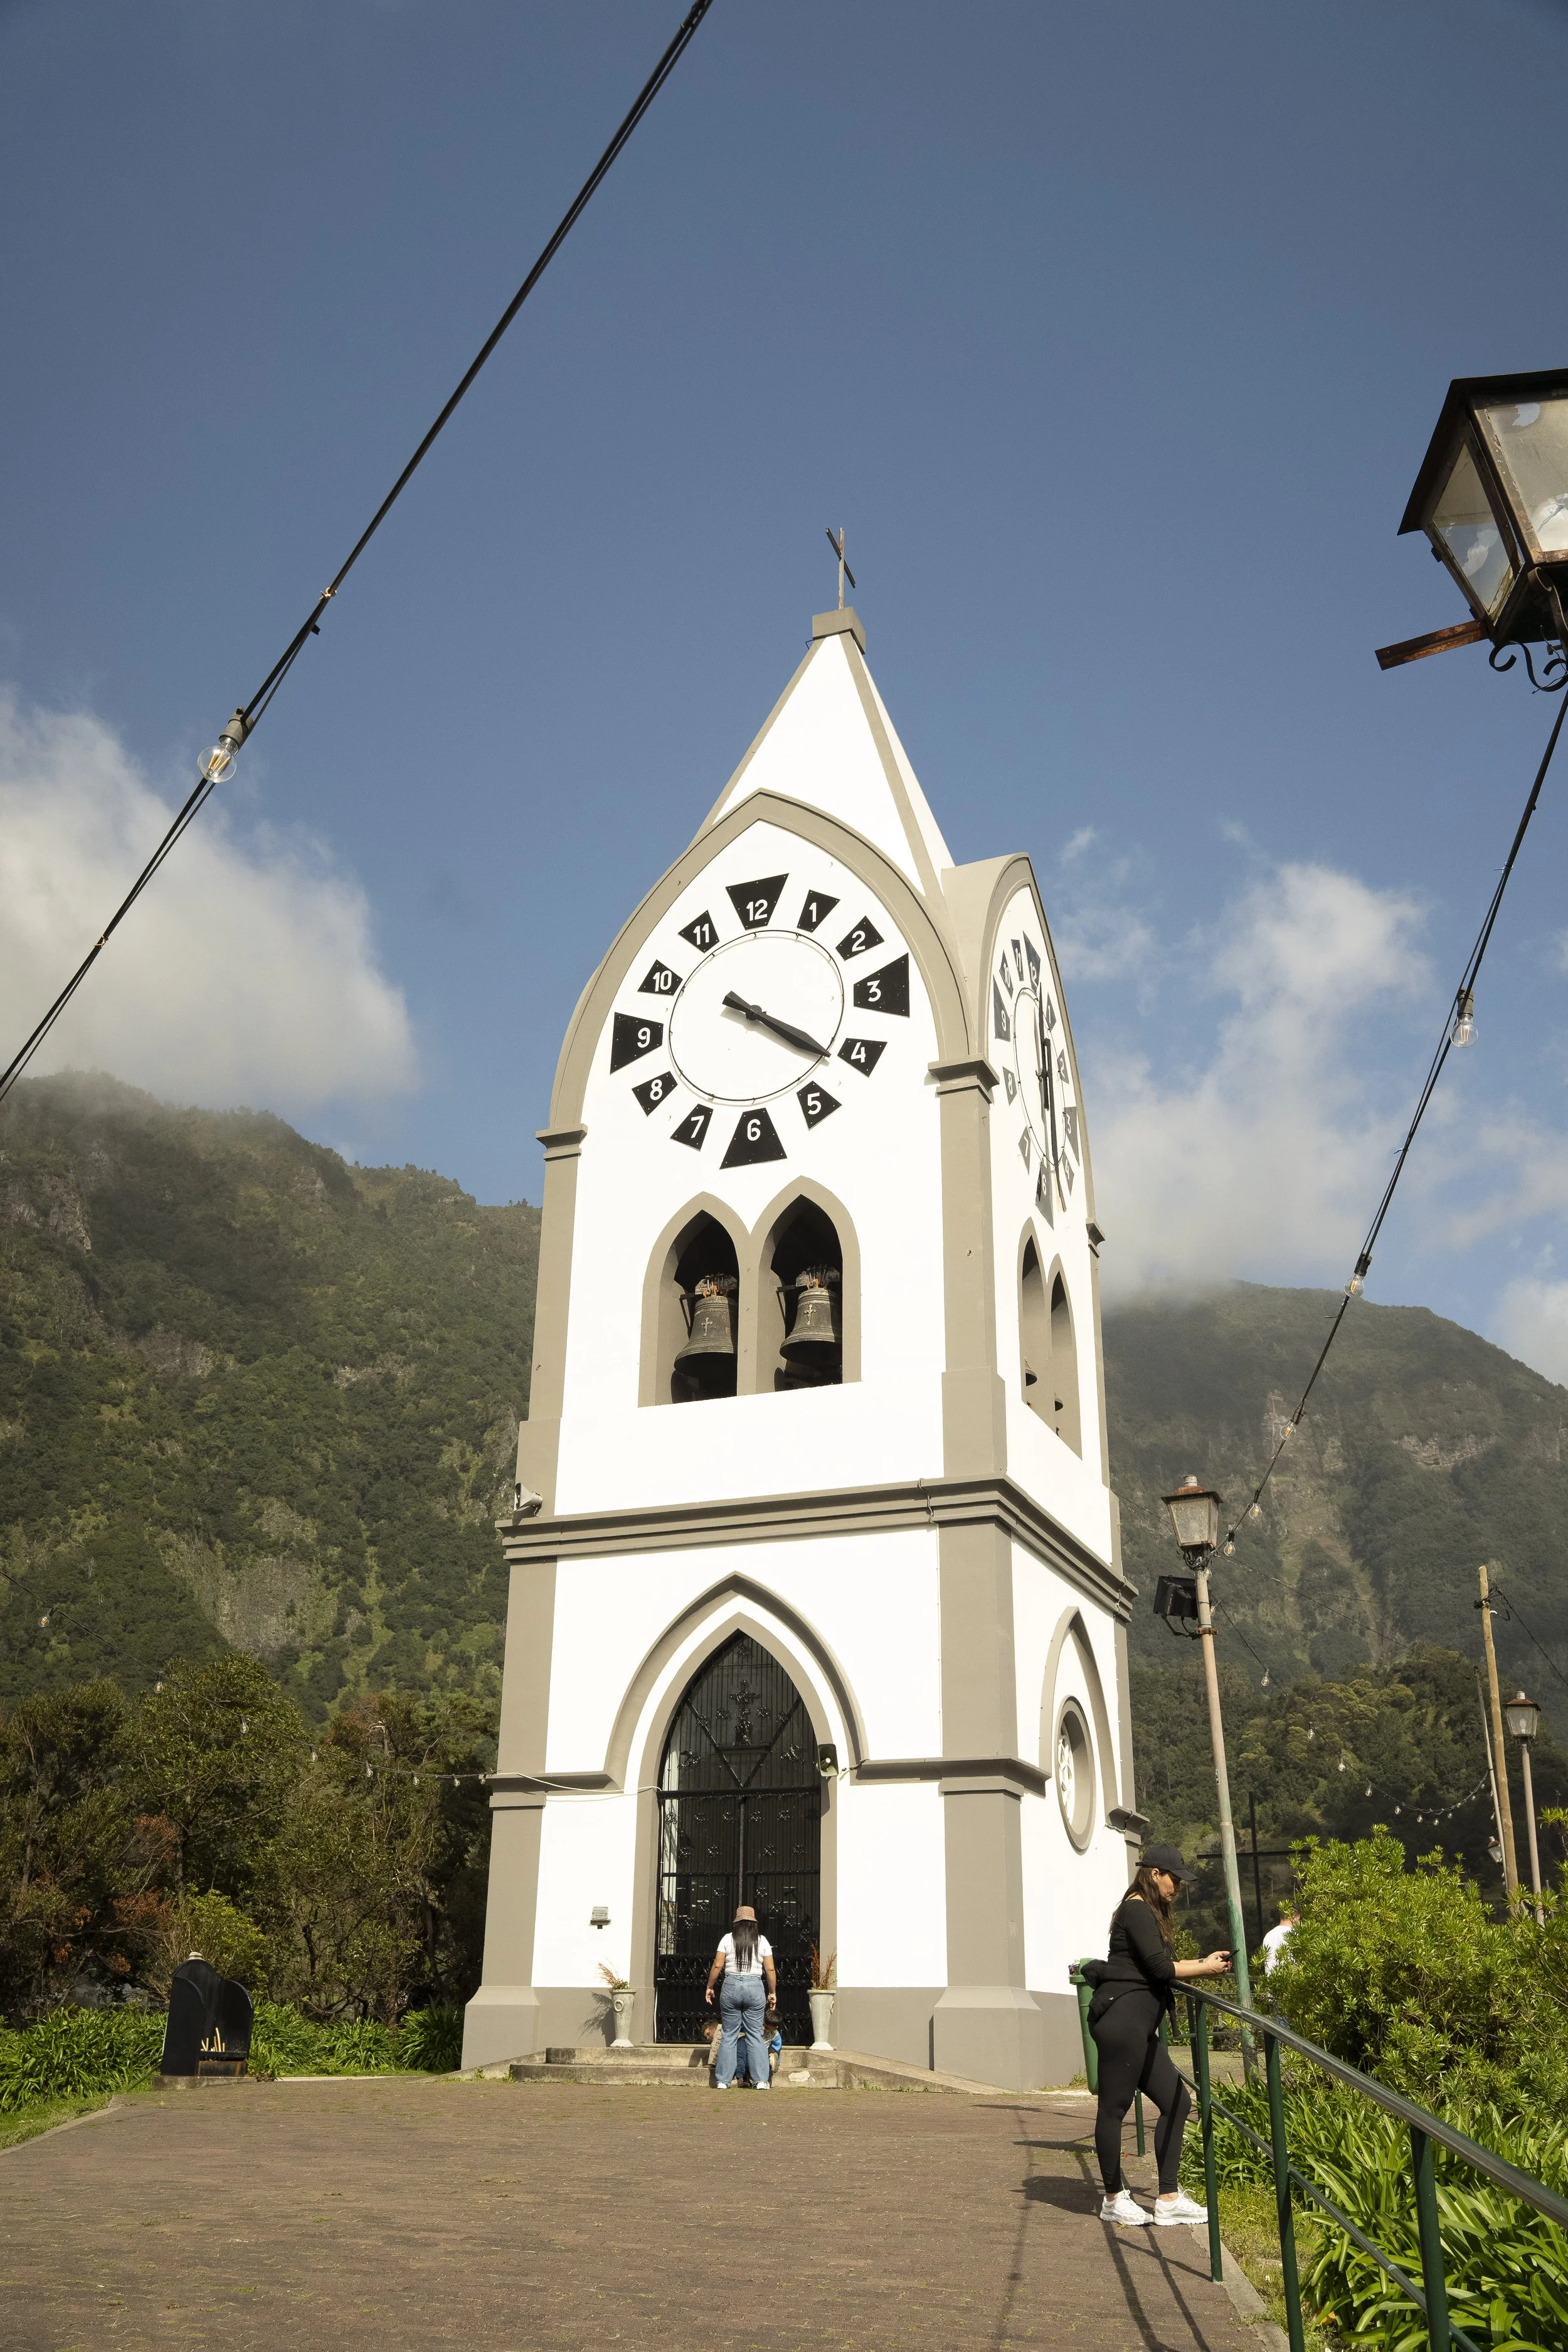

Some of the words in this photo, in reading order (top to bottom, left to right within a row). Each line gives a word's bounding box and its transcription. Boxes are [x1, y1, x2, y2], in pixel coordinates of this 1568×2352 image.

[746, 899, 768, 921] 12
[808, 902, 817, 923] 1
[692, 923, 709, 945] 11
[851, 930, 866, 952] 2
[1015, 947, 1022, 973] 11
[652, 970, 672, 992] 10
[1004, 962, 1010, 988] 10
[1029, 961, 1038, 989] 12
[867, 979, 882, 1002] 3
[1001, 1010, 1007, 1032] 9
[1047, 1005, 1051, 1024] 1
[637, 1027, 651, 1049] 9
[850, 1041, 866, 1063] 4
[1060, 1057, 1065, 1078] 2
[649, 1079, 663, 1101] 8
[1008, 1073, 1013, 1095] 8
[807, 1092, 822, 1115] 5
[691, 1115, 705, 1138] 7
[747, 1118, 761, 1142] 6
[1066, 1113, 1071, 1135] 3
[1024, 1135, 1029, 1158] 7
[1065, 1158, 1069, 1180] 4
[1042, 1173, 1047, 1195] 6
